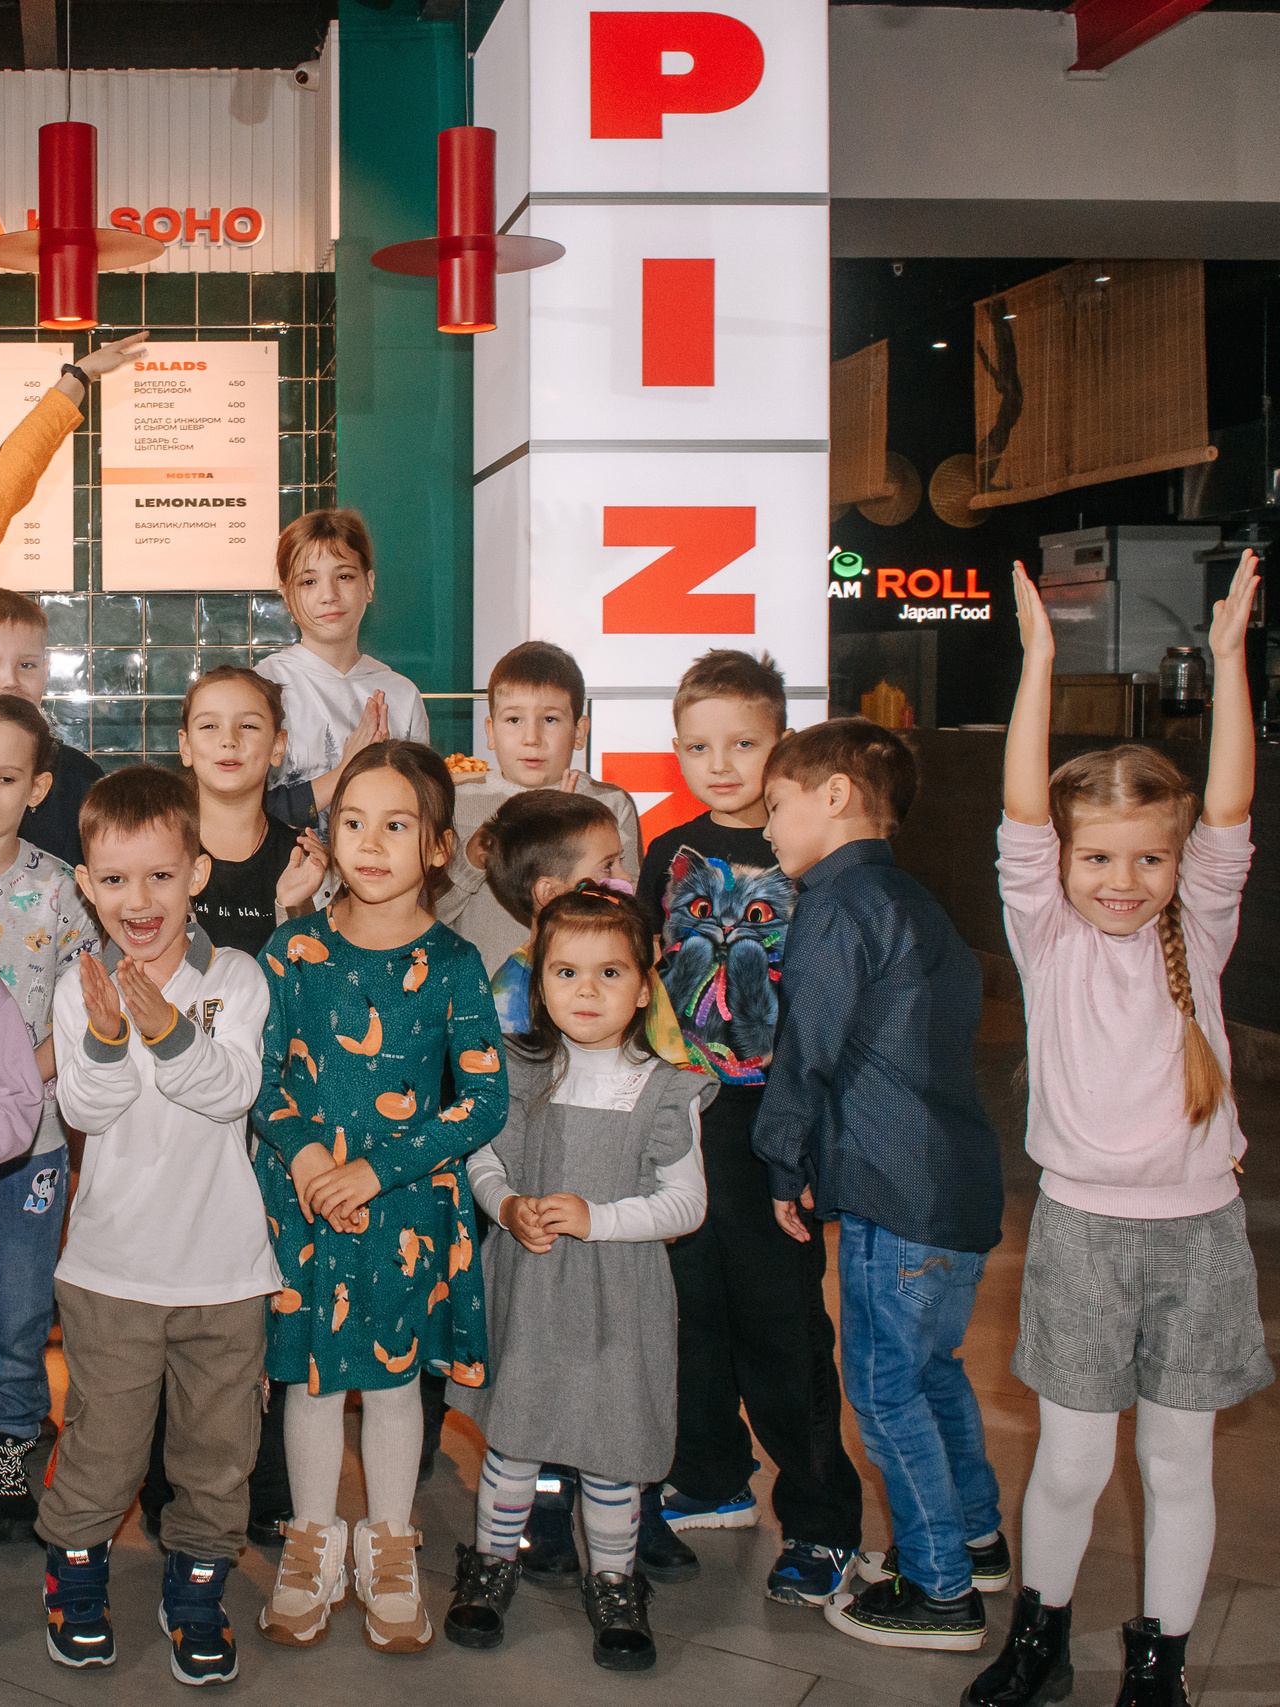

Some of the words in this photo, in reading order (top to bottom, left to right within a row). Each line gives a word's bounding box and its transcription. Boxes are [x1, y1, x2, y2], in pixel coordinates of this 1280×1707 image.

[109, 206, 263, 244] SOHO
[134, 361, 208, 372] SALADS
[134, 380, 178, 388] ВИТЕЛЛО
[134, 437, 170, 445] ЦЕЗАРЬ
[134, 497, 247, 508] LEMONADES
[134, 521, 217, 529] БАЗИЛИК/ЛИМОН
[134, 537, 171, 545] ЦИТРУС
[827, 580, 862, 599] AM
[876, 568, 991, 599] ROLL
[897, 603, 947, 623] Japan
[949, 603, 991, 620] Food
